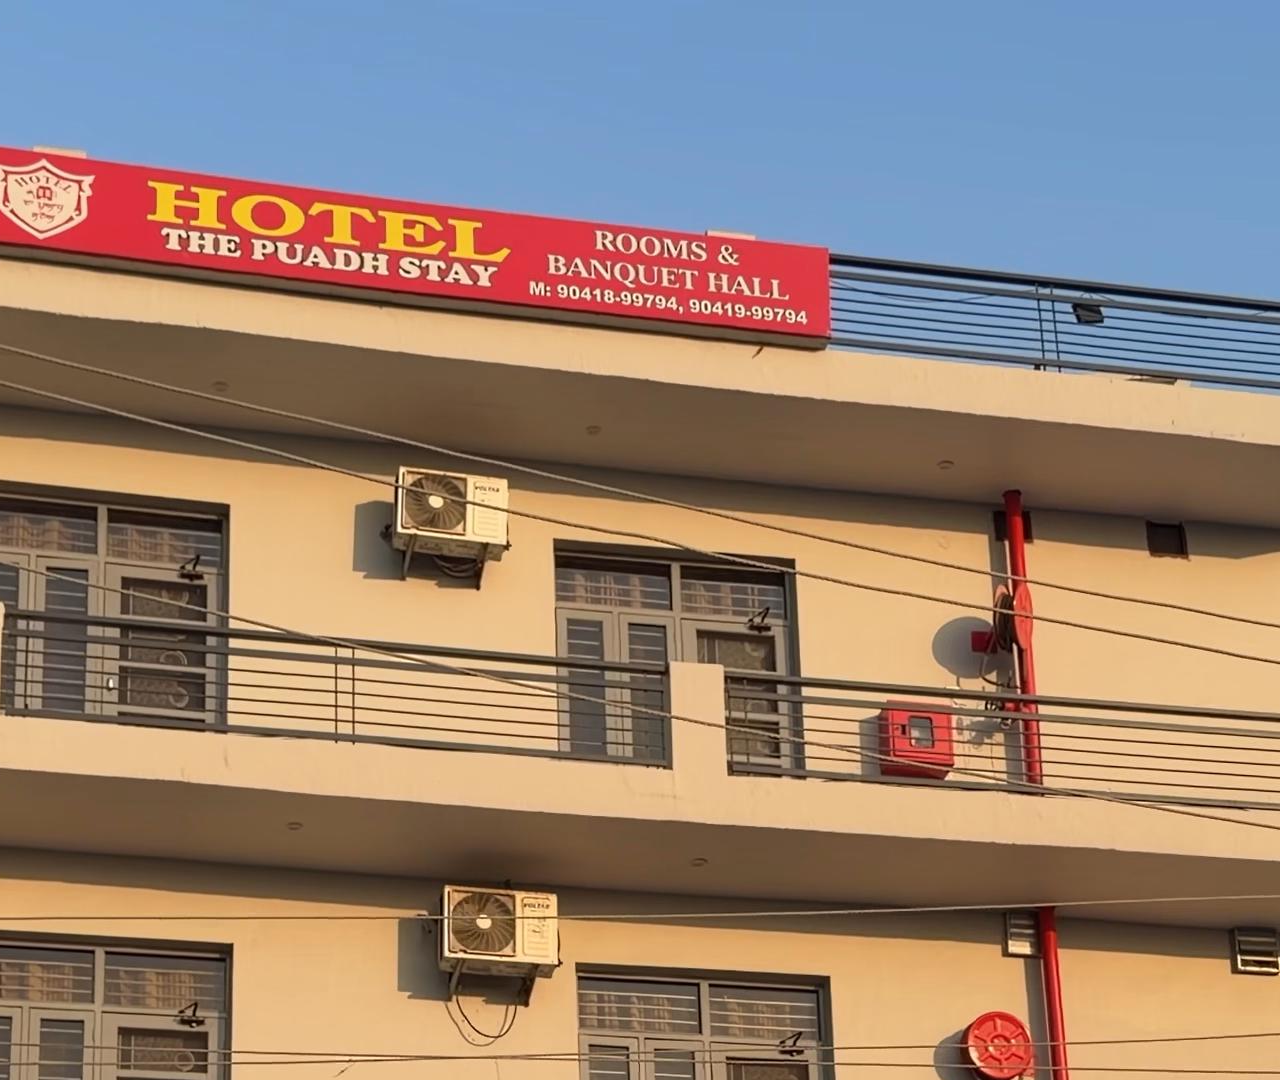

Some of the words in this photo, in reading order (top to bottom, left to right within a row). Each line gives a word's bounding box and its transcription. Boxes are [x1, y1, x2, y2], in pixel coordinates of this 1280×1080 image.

[147, 180, 511, 263] HOTEL
[160, 227, 242, 258] THE
[250, 238, 390, 276] PUADH
[398, 256, 498, 287] STAY
[594, 230, 706, 262] ROOMS
[718, 245, 740, 266] &
[547, 254, 698, 291] BANQUET
[707, 272, 789, 301] HALL
[529, 281, 551, 297] M:
[557, 284, 684, 314] 90418-99794,
[689, 299, 808, 325] 90419-99794
